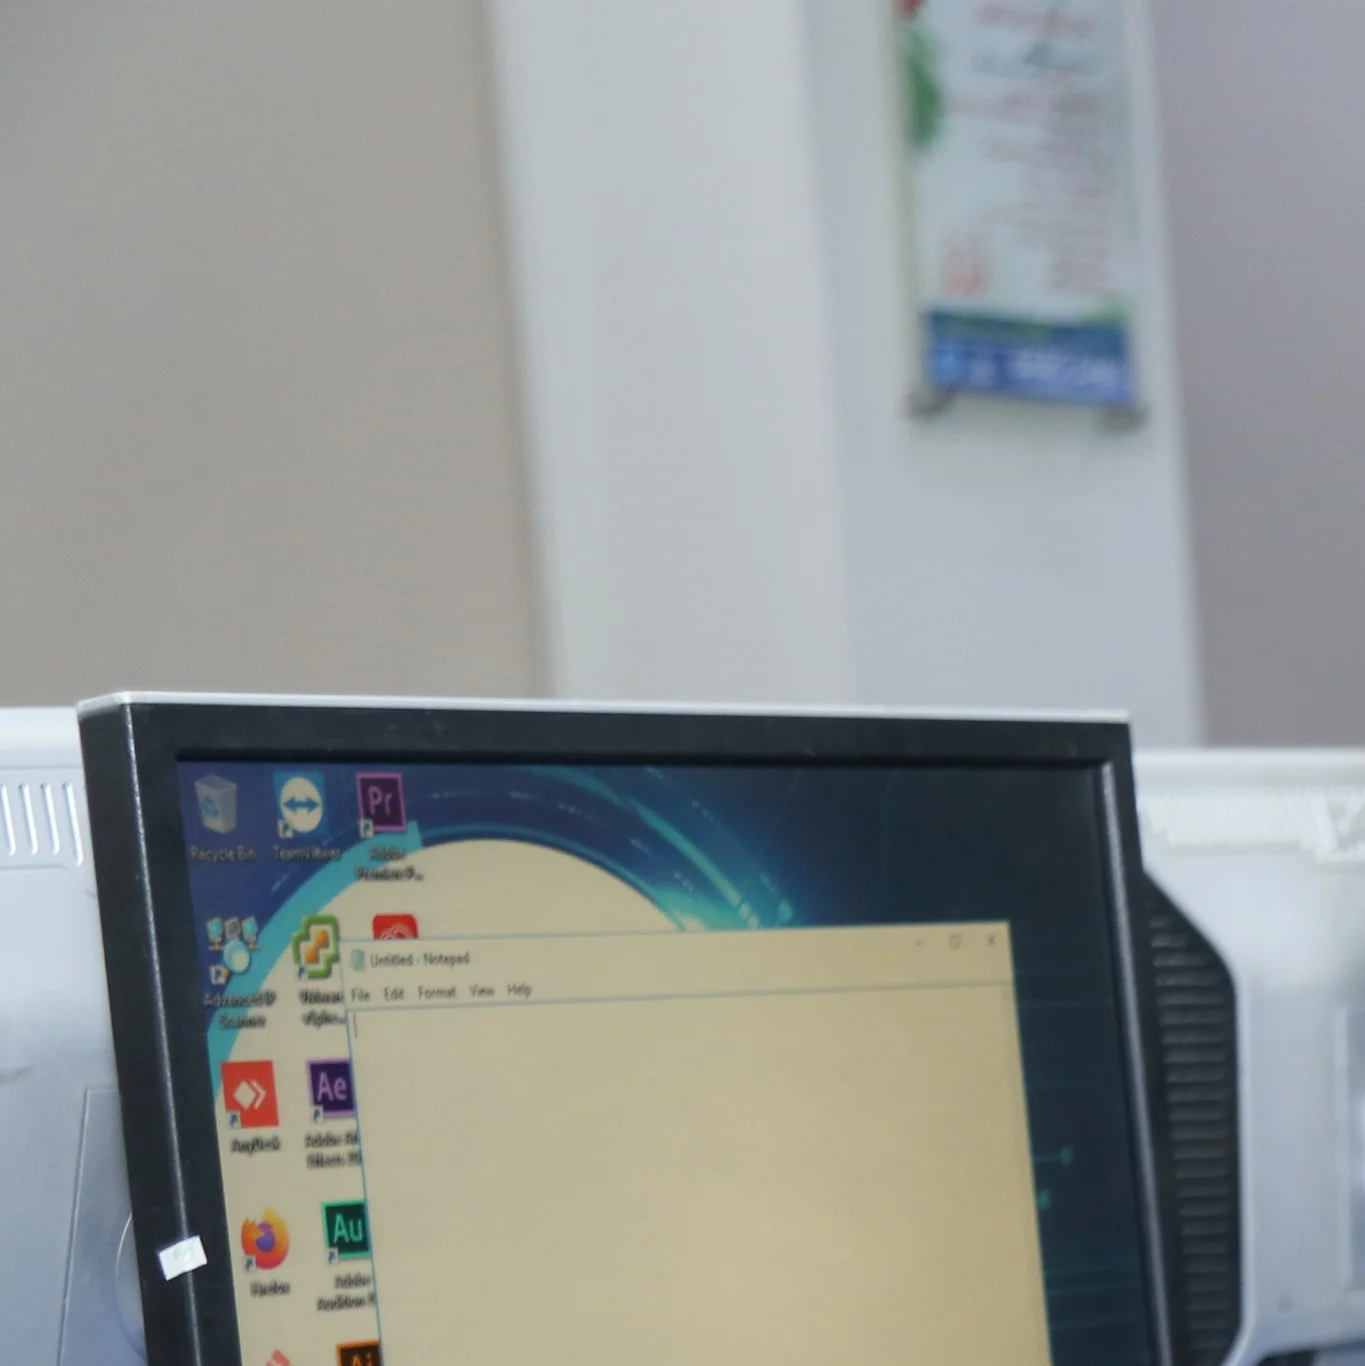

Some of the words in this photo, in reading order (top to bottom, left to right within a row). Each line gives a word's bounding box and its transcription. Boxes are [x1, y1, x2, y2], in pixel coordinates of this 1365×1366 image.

[368, 786, 391, 817] Pr
[190, 847, 235, 863] Recycle
[238, 846, 258, 860] Bin
[273, 846, 341, 861] TeamViewer
[370, 953, 414, 968] Untitled
[424, 951, 470, 970] Notepad
[351, 987, 370, 1001] File
[384, 986, 405, 1001] Edit
[418, 984, 456, 999] Format
[469, 983, 495, 998] View
[507, 981, 532, 998] Help
[317, 1071, 347, 1101] Ae
[333, 1213, 363, 1244] Au
